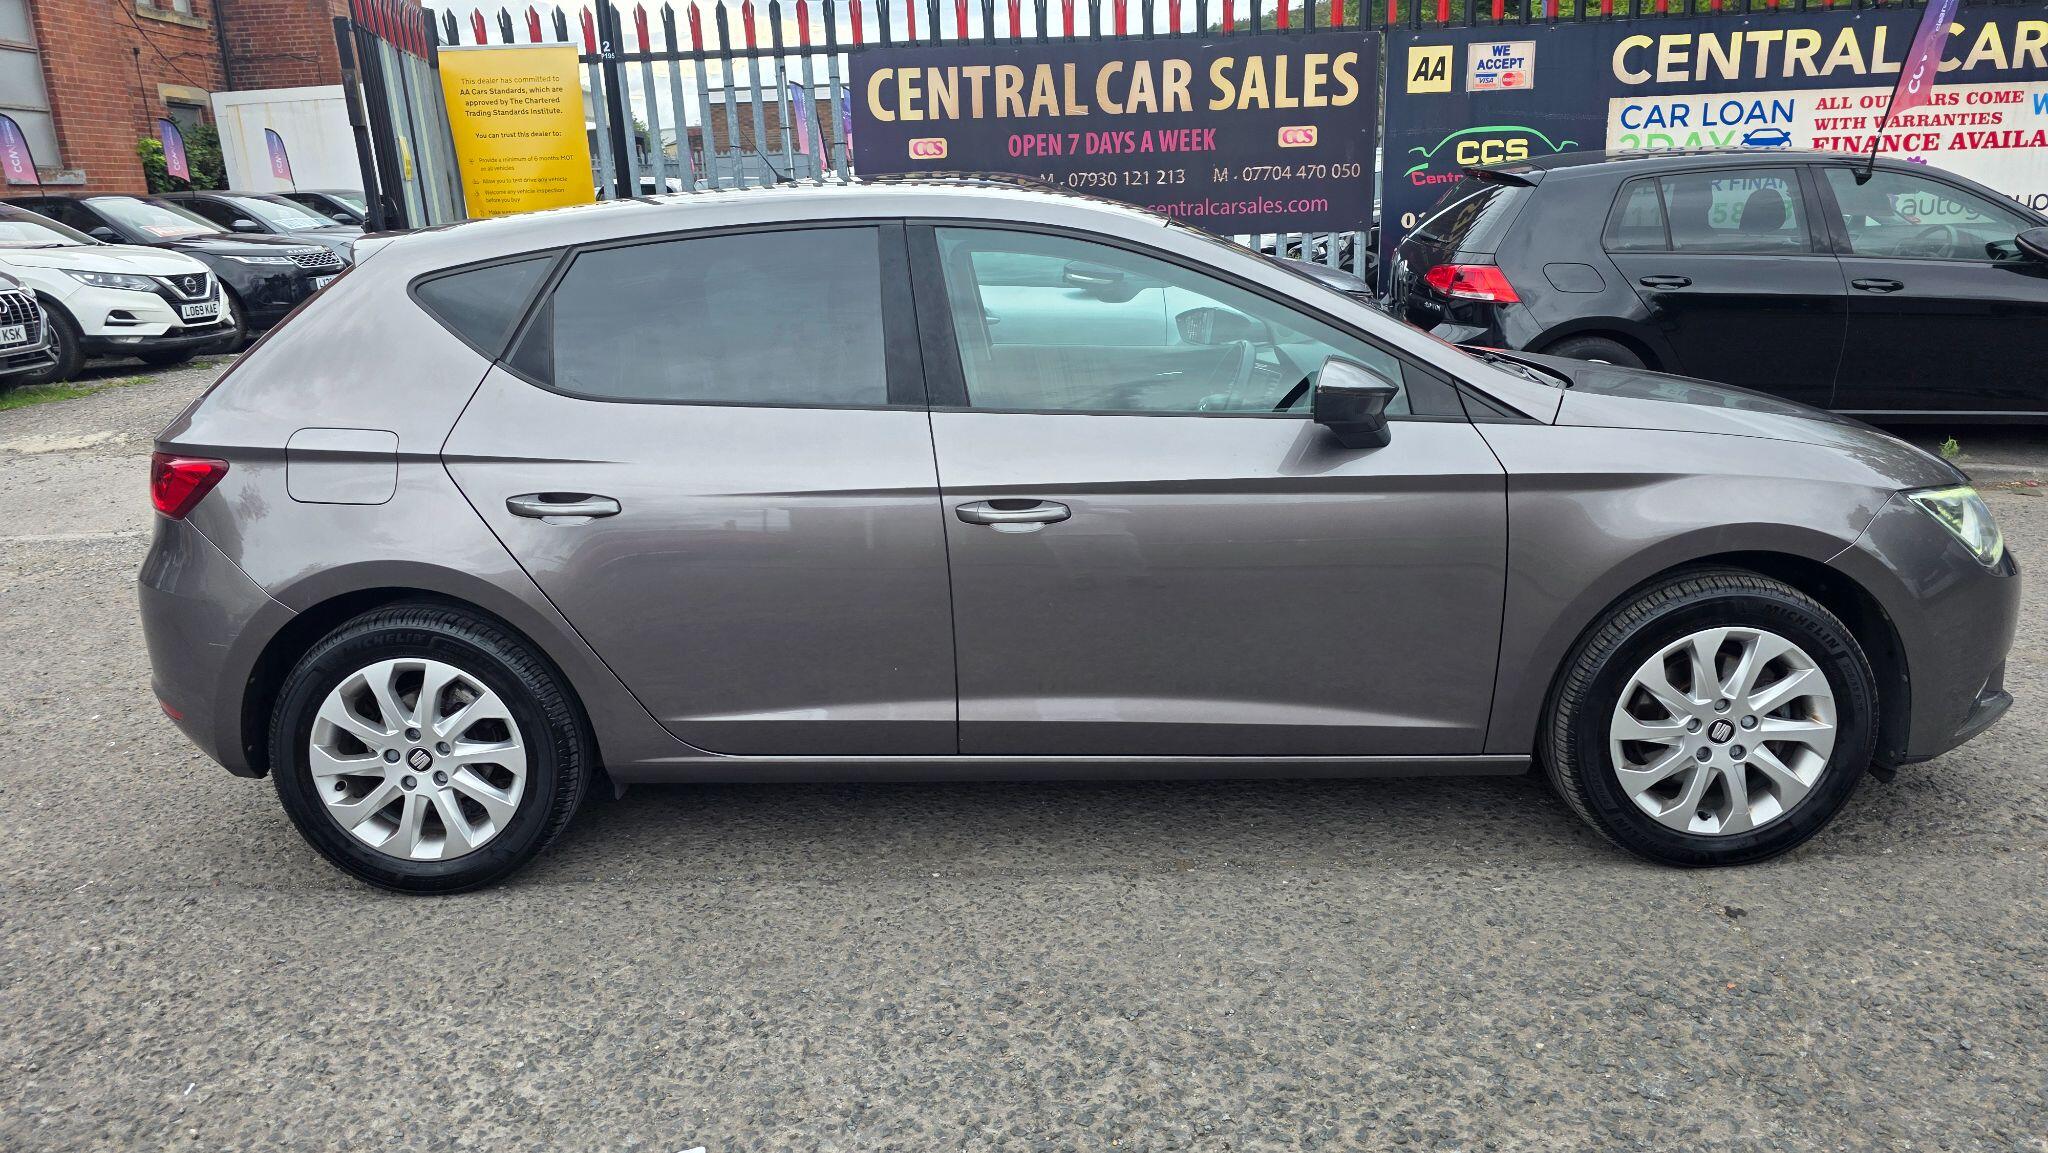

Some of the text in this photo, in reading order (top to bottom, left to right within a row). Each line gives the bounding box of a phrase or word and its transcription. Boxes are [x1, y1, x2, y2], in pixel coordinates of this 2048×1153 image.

[602, 41, 610, 52] 2
[1492, 45, 1510, 56] WE
[1612, 26, 1900, 85] CENTRAL
[1412, 56, 1445, 81] AA
[1477, 58, 1524, 70] ACCEPT
[867, 63, 1089, 122] CENTRAL
[1096, 59, 1193, 114] CAR
[1208, 52, 1359, 111] SALES
[500, 98, 508, 106] by
[1816, 96, 1852, 110] ALL
[1860, 95, 1892, 109] OU
[1967, 91, 2024, 105] COME
[465, 110, 491, 118] Trading
[1620, 99, 1795, 129] CAR LOAN
[1814, 112, 2003, 131] WITH WARRANTIES
[1008, 128, 1216, 158] OPEN 7 DAYS A WEEK
[1282, 128, 1313, 144] CCS
[1812, 133, 1940, 152] FINANCE
[913, 141, 944, 156] CCS
[1457, 138, 1528, 165] CCS
[1068, 172, 1116, 187] 07930
[1123, 171, 1149, 185] 121
[1156, 169, 1185, 184] 213
[1243, 166, 1292, 181] 07704
[1296, 165, 1326, 179] 470
[1332, 163, 1360, 178] 050
[1412, 171, 1464, 186] Centr
[205, 304, 217, 314] KAE
[2, 328, 22, 341] KSK
[1764, 604, 1841, 650] MICHELIN
